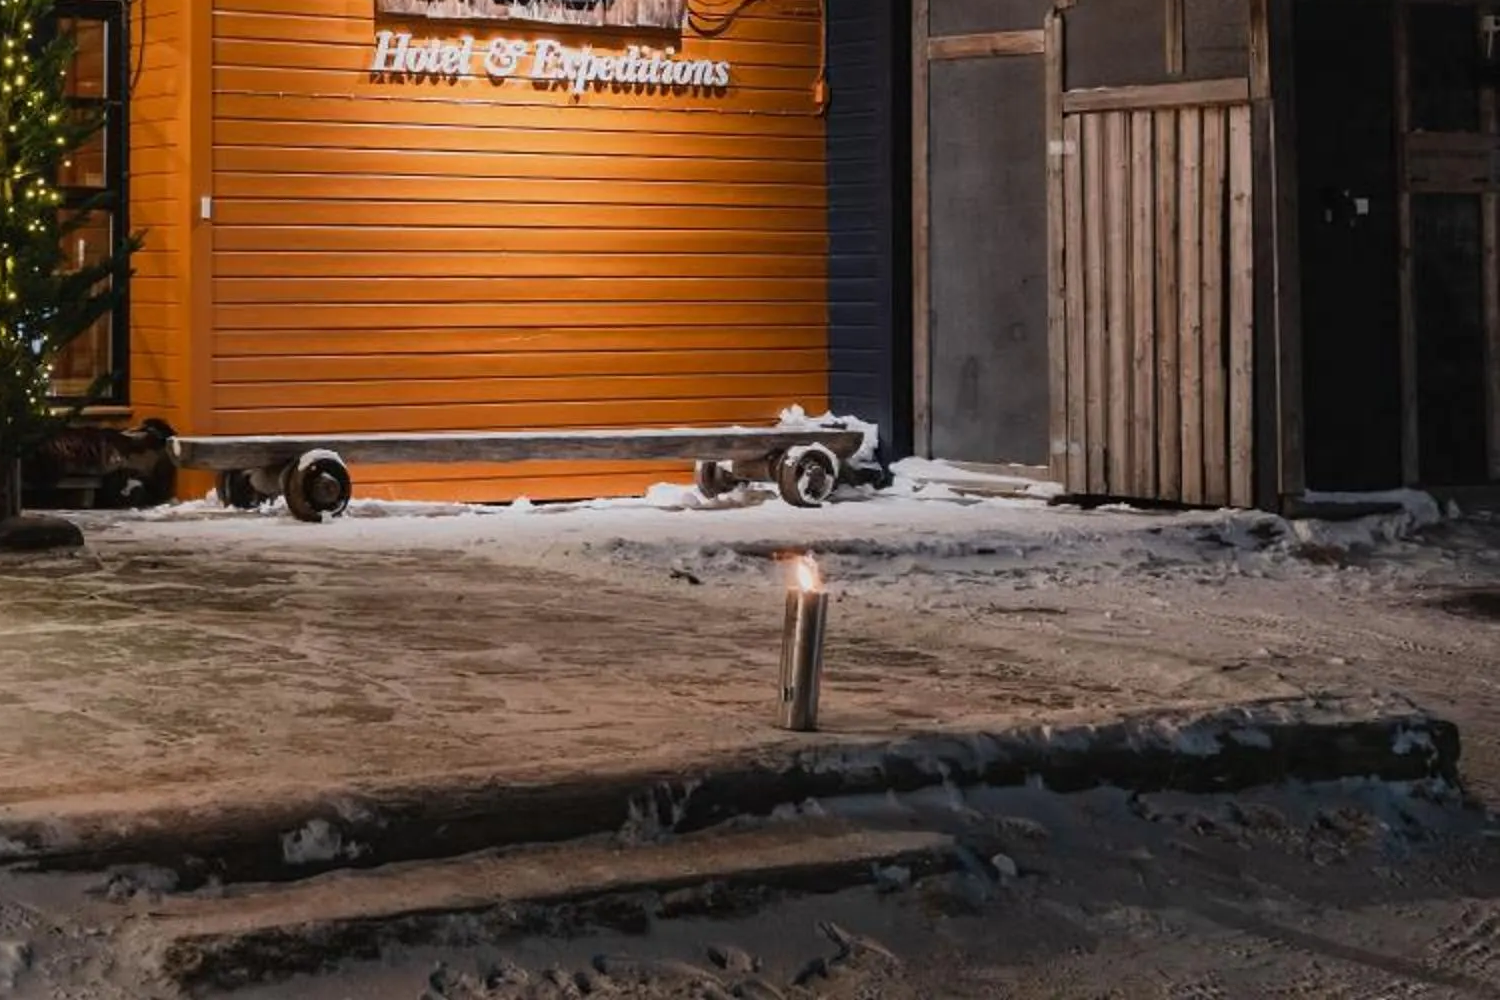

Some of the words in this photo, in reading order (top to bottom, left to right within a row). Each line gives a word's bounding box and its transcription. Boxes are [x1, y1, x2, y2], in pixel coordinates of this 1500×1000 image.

[373, 30, 475, 75] Hotel
[484, 36, 528, 77] &
[530, 38, 731, 94] Expeditions
